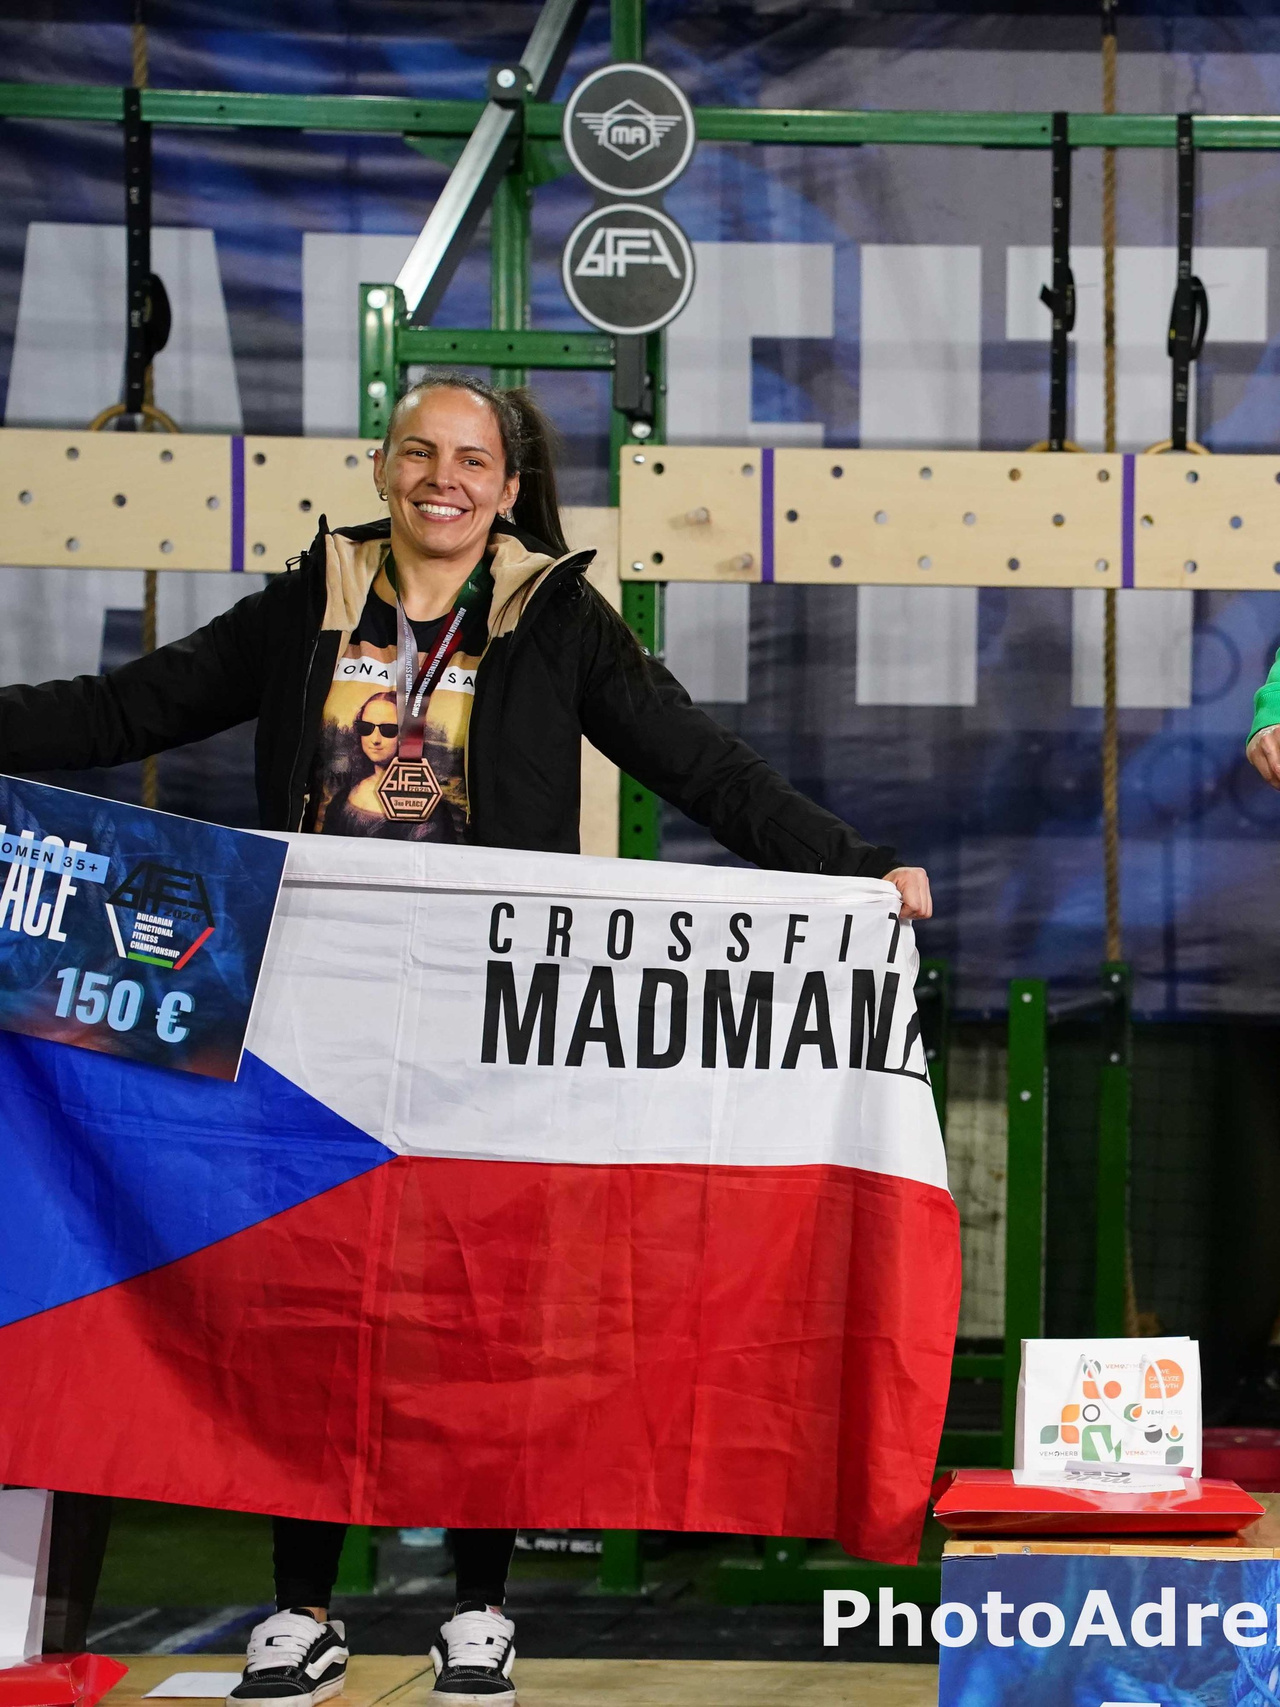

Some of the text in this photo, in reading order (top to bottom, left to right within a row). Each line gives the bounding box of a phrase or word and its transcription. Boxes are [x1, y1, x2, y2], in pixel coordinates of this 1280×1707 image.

[63, 856, 98, 873] 35+
[136, 912, 173, 928] BULGARIAN
[132, 931, 159, 944] FITNESS
[134, 922, 174, 938] FUNCTIONAL
[488, 901, 900, 965] CROSSFIT
[130, 940, 180, 959] CHAMPIONSHIP
[55, 966, 195, 1043] 150 €
[481, 959, 901, 1071] MADMAN
